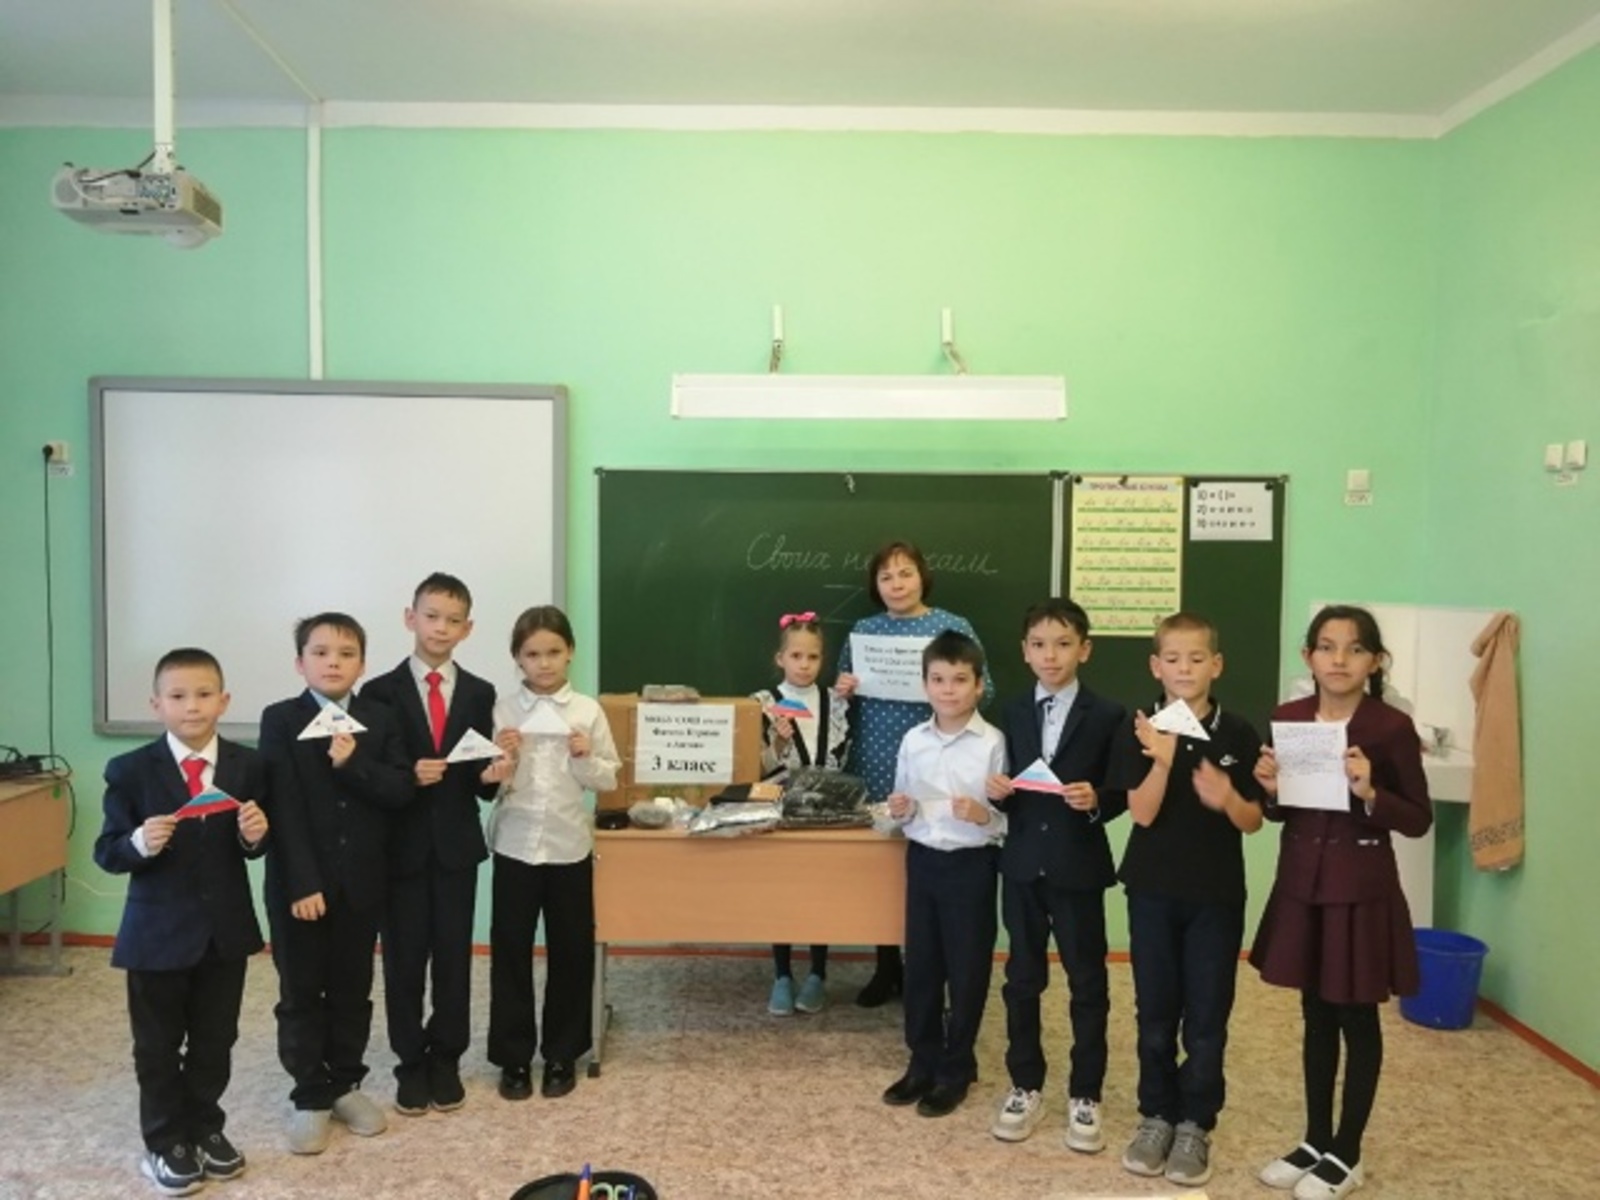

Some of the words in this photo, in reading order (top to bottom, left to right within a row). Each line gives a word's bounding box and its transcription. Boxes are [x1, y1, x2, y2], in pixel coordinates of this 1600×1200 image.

[747, 532, 831, 570] Своих
[651, 755, 661, 771] 3
[667, 760, 716, 773] класс
